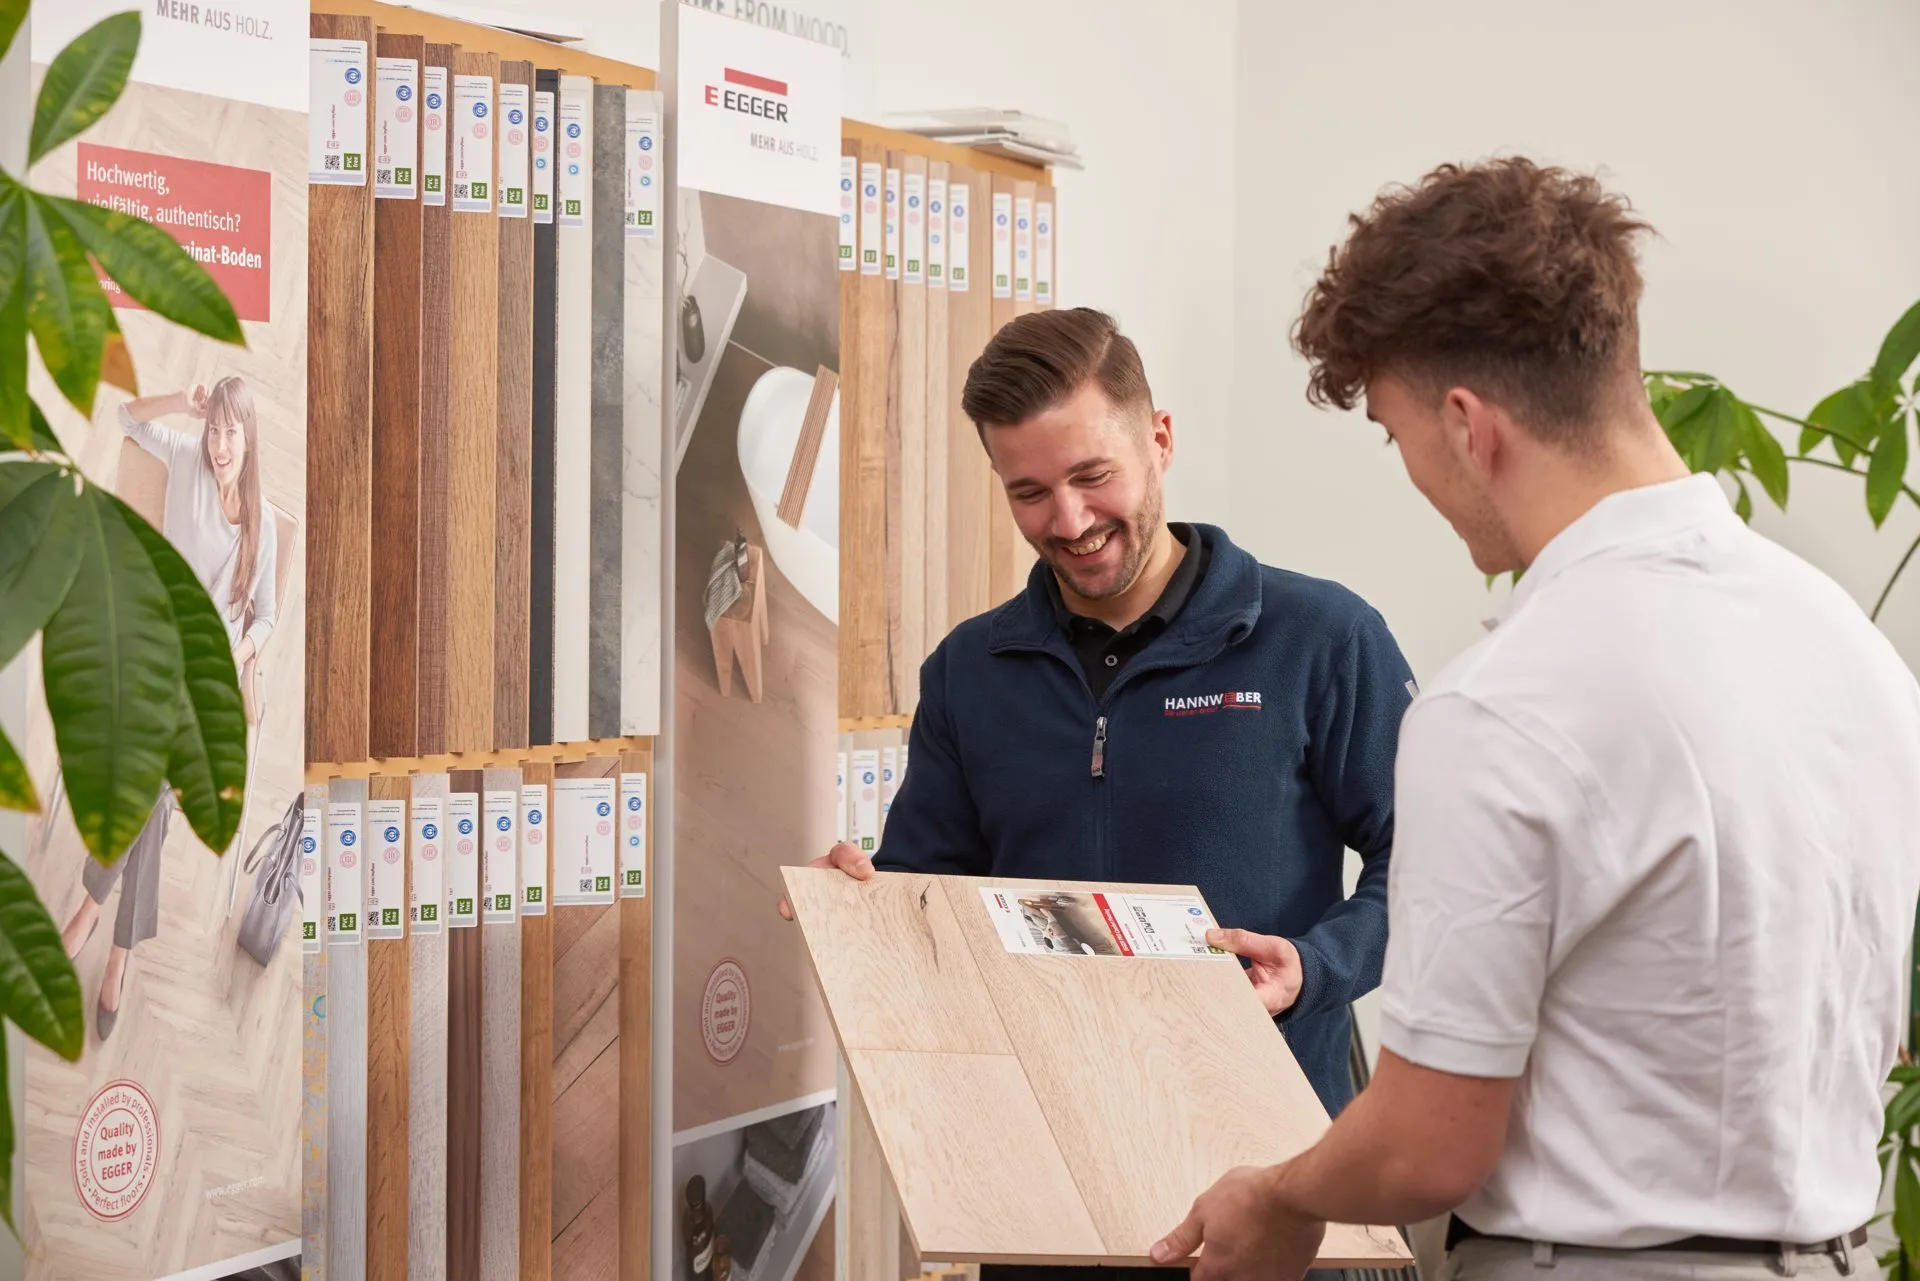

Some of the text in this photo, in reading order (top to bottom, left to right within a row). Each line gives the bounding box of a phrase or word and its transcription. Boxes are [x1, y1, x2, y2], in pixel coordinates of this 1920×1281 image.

[157, 0, 273, 40] MEHR AUS HOLZ.
[724, 90, 788, 123] EGGER
[750, 132, 776, 152] MEHR
[778, 139, 795, 156] AUS
[87, 160, 170, 195] Hochwertig,
[156, 205, 241, 232] authentisch?
[180, 240, 262, 268] inat-Boden
[716, 990, 737, 1004] Quality
[714, 1008, 729, 1019] made
[717, 1021, 736, 1034] EGGER
[79, 1092, 153, 1188] Sold and installed by professionals
[100, 1122, 135, 1141] Quality
[97, 1142, 137, 1161] made by
[101, 1161, 133, 1181] EGGER
[120, 1181, 144, 1207] floors
